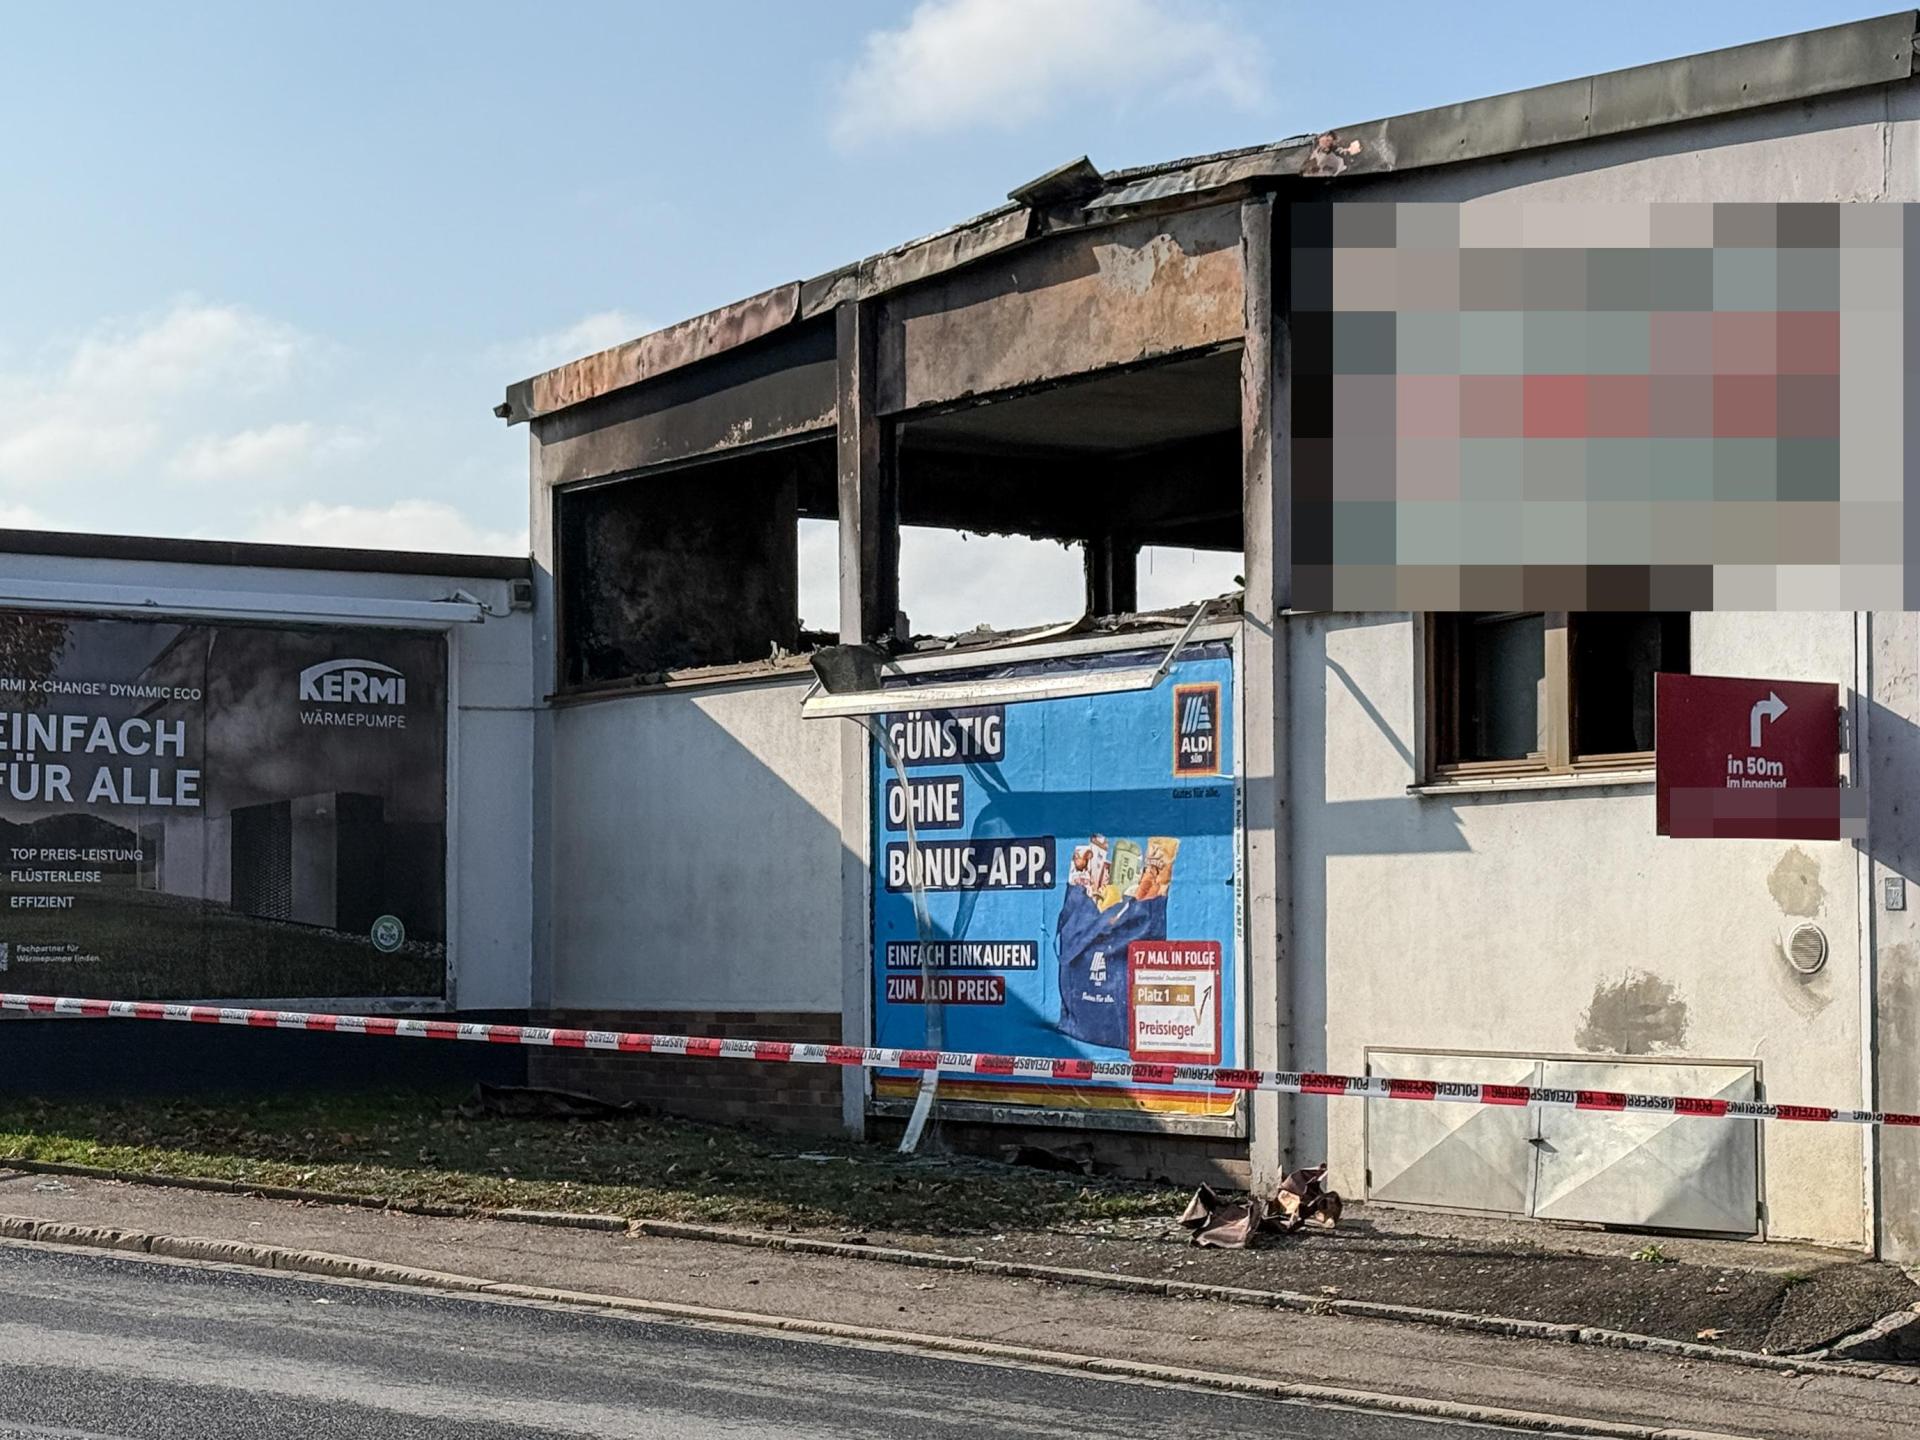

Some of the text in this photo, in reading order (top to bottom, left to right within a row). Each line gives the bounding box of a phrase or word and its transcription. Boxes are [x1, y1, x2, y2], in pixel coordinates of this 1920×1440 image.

[110, 684, 171, 698] DYNAMIC
[174, 688, 201, 700] ECO
[300, 659, 406, 705] KERMI
[300, 709, 407, 728] WÄRMEPUMPE
[889, 711, 1001, 760] GÜNSTIG
[1181, 736, 1213, 753] ALDI
[1728, 754, 1783, 776] in 50m
[87, 766, 201, 806] ALLE
[889, 783, 960, 824] OHNE
[10, 848, 144, 861] TOP PREIS-LEISTUNG
[10, 868, 102, 882] FLÜSTERLEISE
[889, 846, 1052, 888] BONUS-APP.
[10, 896, 75, 908] EFFIZIENT
[888, 944, 1036, 966] EINFACH EINKAUFEN.
[1134, 951, 1216, 966] 17 MAL IN FOLGE
[888, 979, 917, 1000] ZUM
[957, 979, 1003, 1001] PREIS.
[1138, 987, 1163, 1002] Platz
[1164, 989, 1170, 1002] 1
[1139, 1020, 1195, 1040] Preissieger
